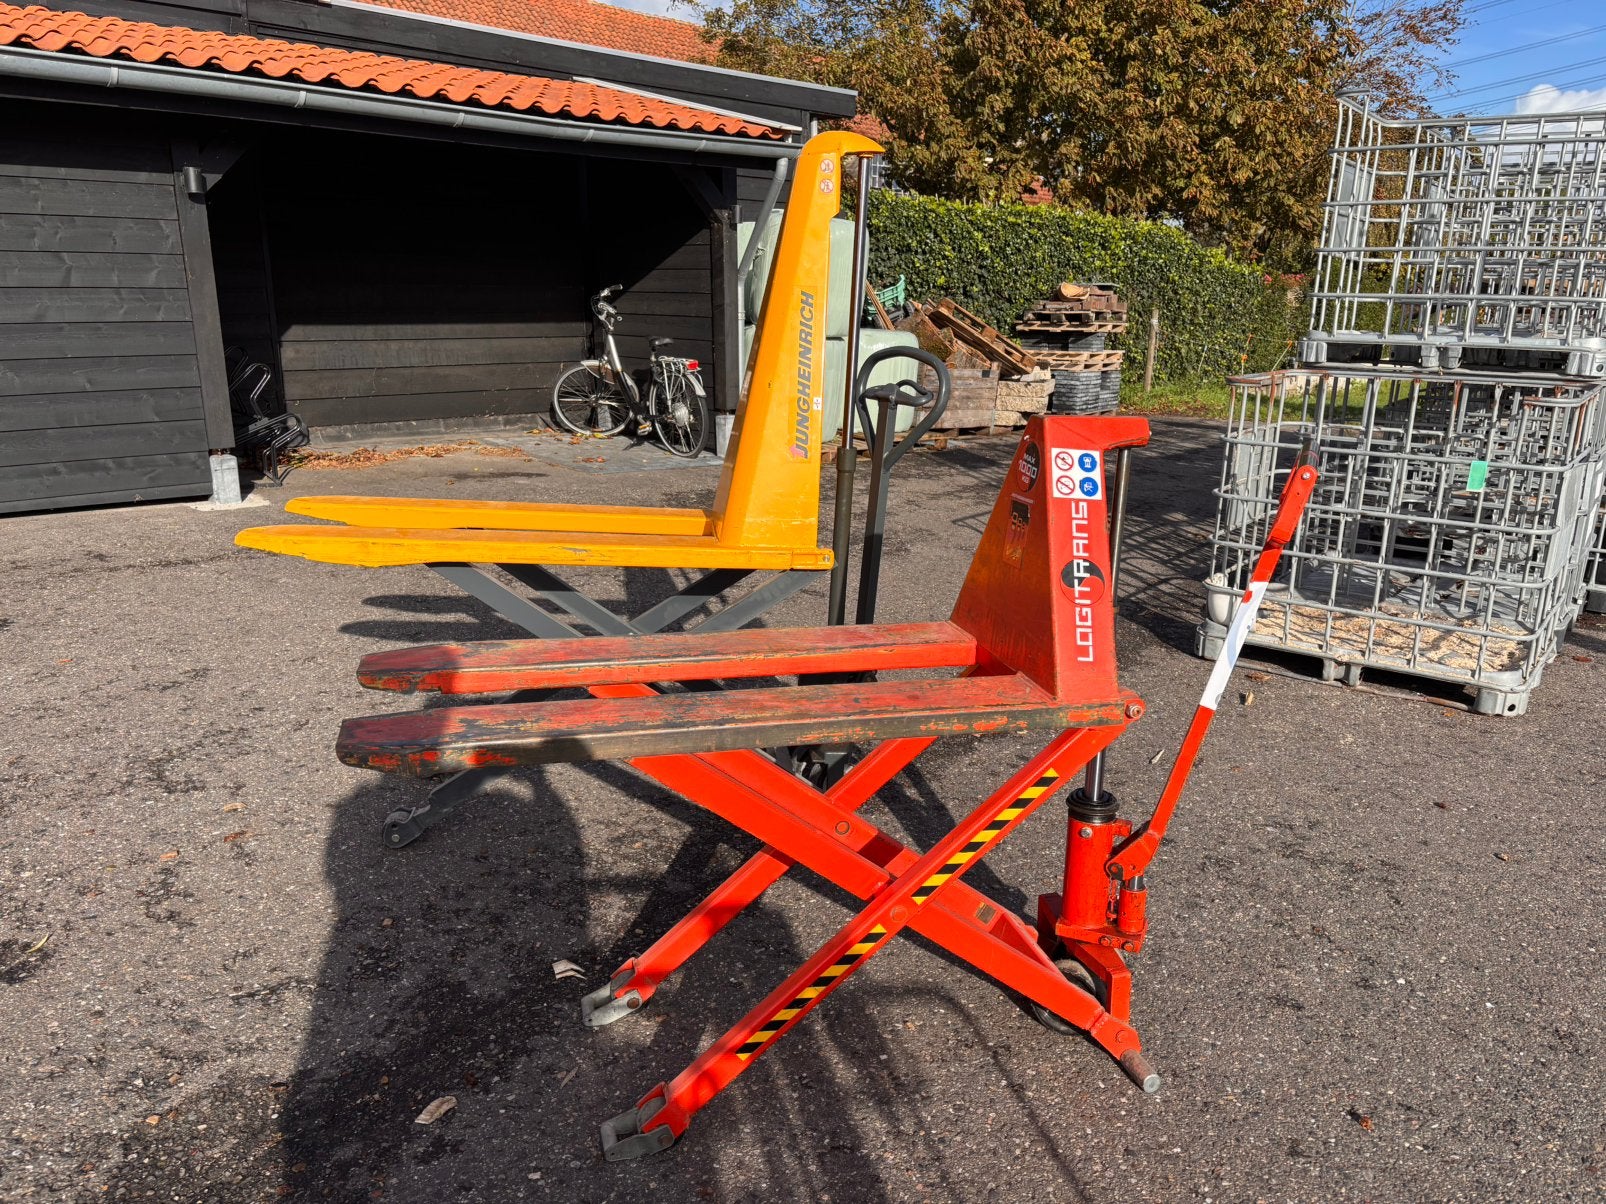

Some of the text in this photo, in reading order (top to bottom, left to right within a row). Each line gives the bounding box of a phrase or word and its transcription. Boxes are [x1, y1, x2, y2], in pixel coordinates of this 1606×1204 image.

[794, 290, 815, 459] JUNGHEINRICH
[1018, 459, 1038, 479] 1000
[1023, 453, 1036, 464] MAX
[1071, 501, 1094, 662] LOGITRANS
